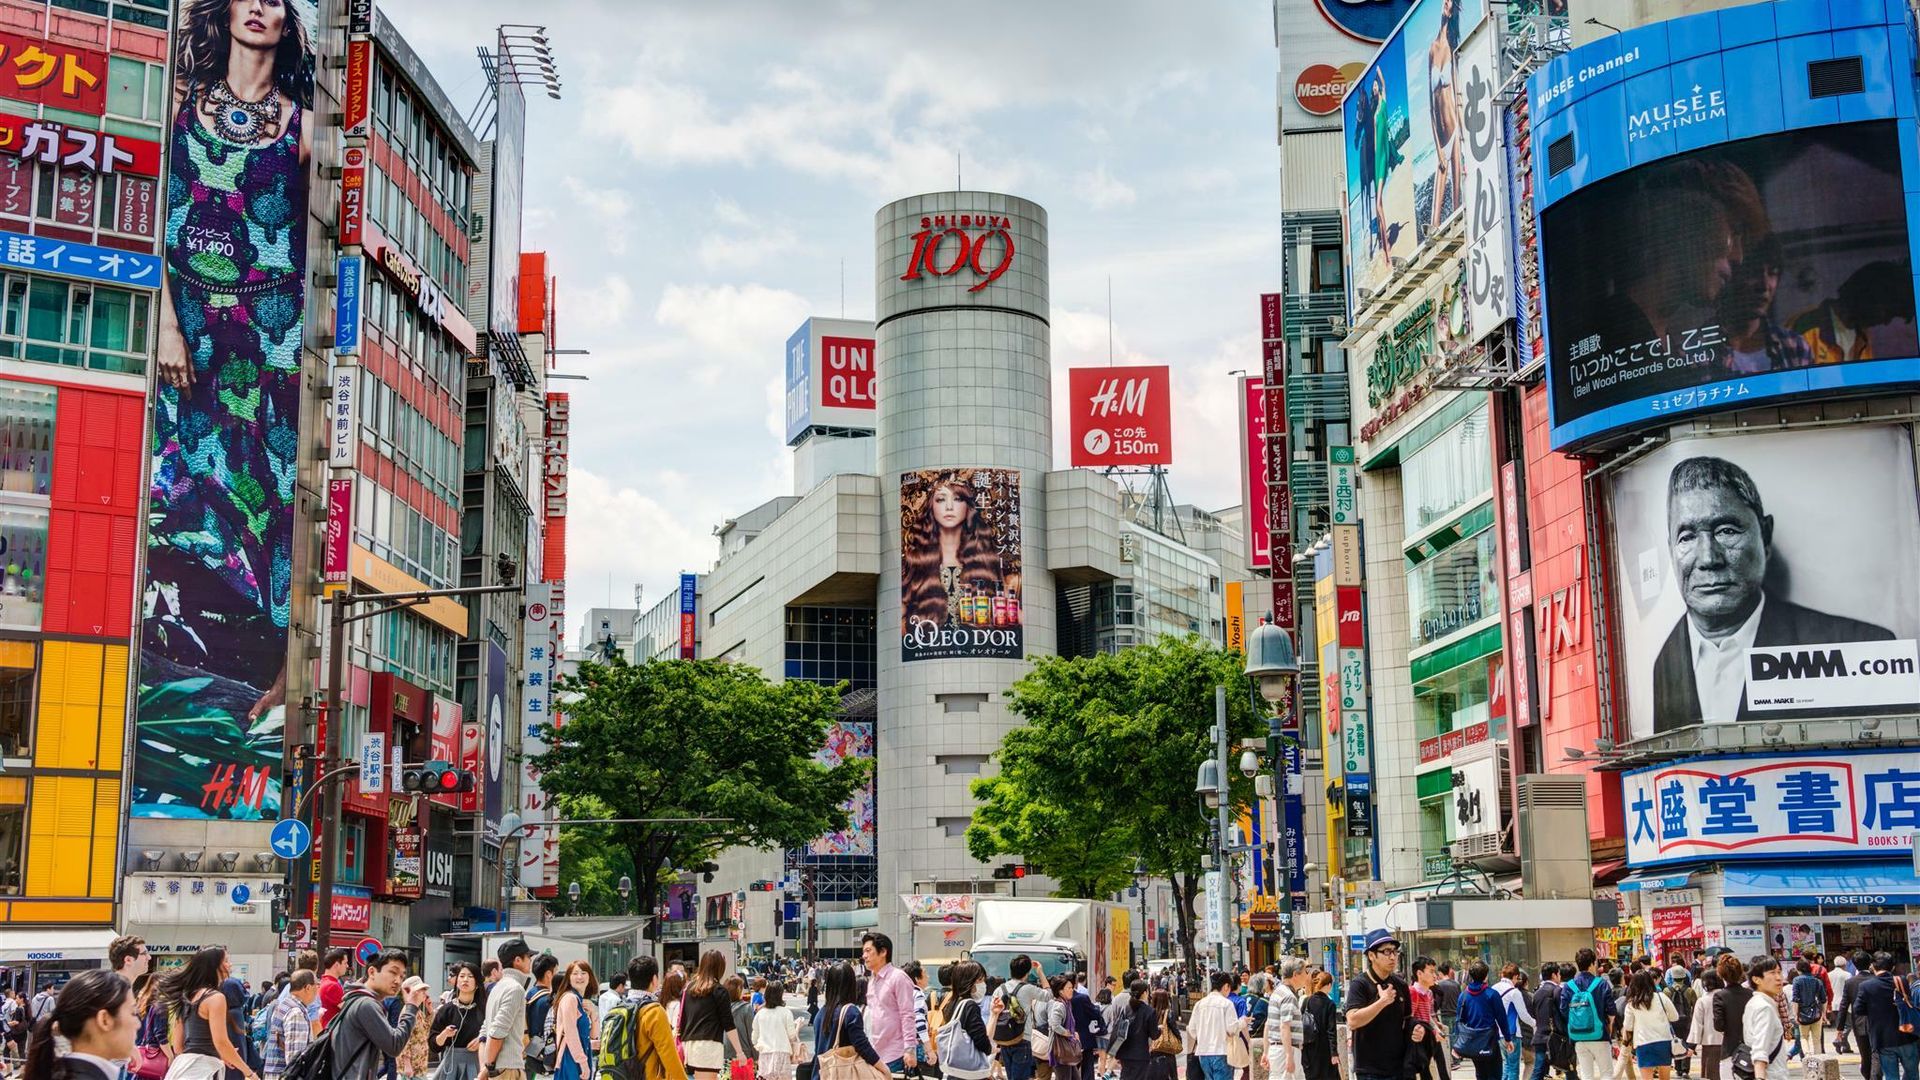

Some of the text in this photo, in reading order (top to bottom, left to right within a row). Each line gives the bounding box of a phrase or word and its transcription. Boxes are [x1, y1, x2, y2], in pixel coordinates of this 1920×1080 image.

[0, 45, 98, 95] クト
[351, 43, 364, 122] プライス コンタクト
[1538, 46, 1640, 110] MUSEE Channel
[353, 126, 365, 135] 8F
[1629, 107, 1726, 143] PLATINUM
[21, 122, 134, 174] ガスト
[5, 157, 21, 212] オープン
[59, 177, 77, 213] 募集
[76, 170, 93, 225] スタッフ
[138, 190, 150, 234] 0120
[345, 188, 361, 235] ガスト
[920, 214, 982, 230] SHIBUYA
[185, 225, 232, 242] ワンピース
[0, 236, 154, 280] 話イーオン
[900, 227, 1015, 293] 109
[342, 265, 356, 345] 英会話イーオン
[1569, 333, 1602, 361] 主題歌
[1089, 377, 1150, 418] H&M
[1573, 382, 1591, 400] (Bell
[1592, 372, 1617, 392] Wood
[1619, 360, 1664, 383] Records
[1651, 383, 1750, 411] ミュゼプラチナム
[335, 375, 351, 459] 渋谷駅前ビル
[1113, 426, 1148, 439] この先
[1113, 440, 1160, 456] 150m
[331, 480, 351, 492] 5F
[973, 471, 993, 521] 誕生。
[1336, 467, 1352, 512] 渋谷西村
[994, 472, 1008, 569] オイルシャンプー
[1007, 472, 1020, 555] 世にも贅沢な
[1342, 529, 1351, 575] Euphoria
[325, 570, 348, 582] 美容室
[973, 630, 1018, 647] D'OR
[1231, 616, 1241, 656] iYoshi
[1421, 600, 1478, 640] uphoria
[1353, 660, 1362, 692] フルーツ
[1750, 649, 1914, 681] DMM.com
[526, 646, 544, 738] 洋装生地
[369, 737, 382, 788] 渋谷駅前
[1347, 728, 1356, 759] フルーツ
[201, 763, 272, 811] H&M
[1631, 768, 1920, 846] 大盛堂書店
[1286, 827, 1298, 879] みずほ銀行
[1867, 836, 1900, 847] BOOKS
[142, 880, 273, 895] 渋谷駅前ル
[426, 850, 454, 887] USH
[1639, 879, 1665, 889] TAISEIDO
[1815, 895, 1887, 905] TAISEIDO
[27, 951, 63, 960] KIOSQUE
[943, 939, 965, 947] SEINO
